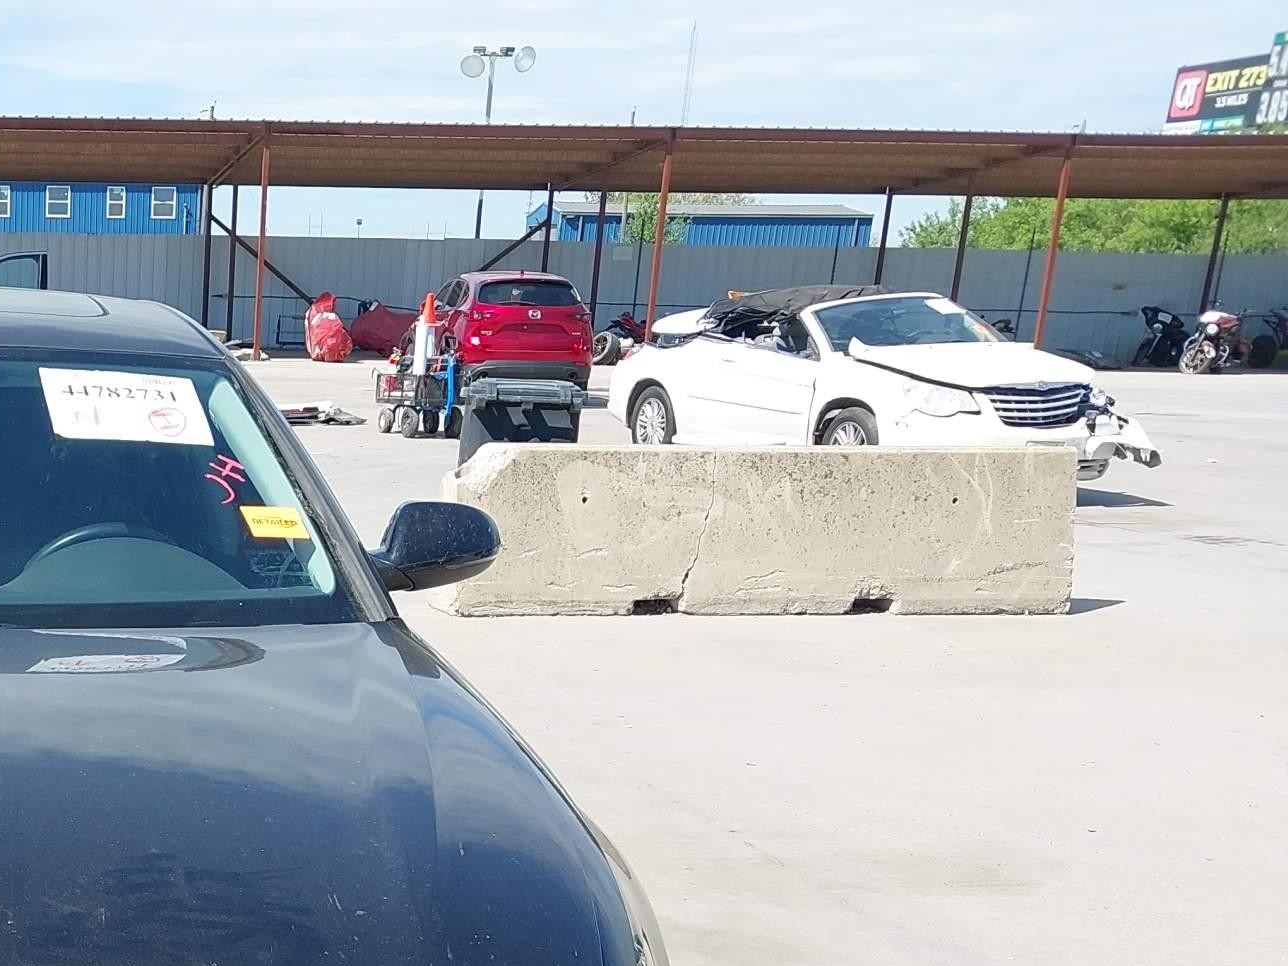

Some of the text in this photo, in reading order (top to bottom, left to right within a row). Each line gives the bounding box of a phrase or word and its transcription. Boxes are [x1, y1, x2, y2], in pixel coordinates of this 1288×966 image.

[1175, 76, 1202, 110] QT
[1205, 65, 1268, 93] EXIT 273
[62, 385, 176, 402] 44782731
